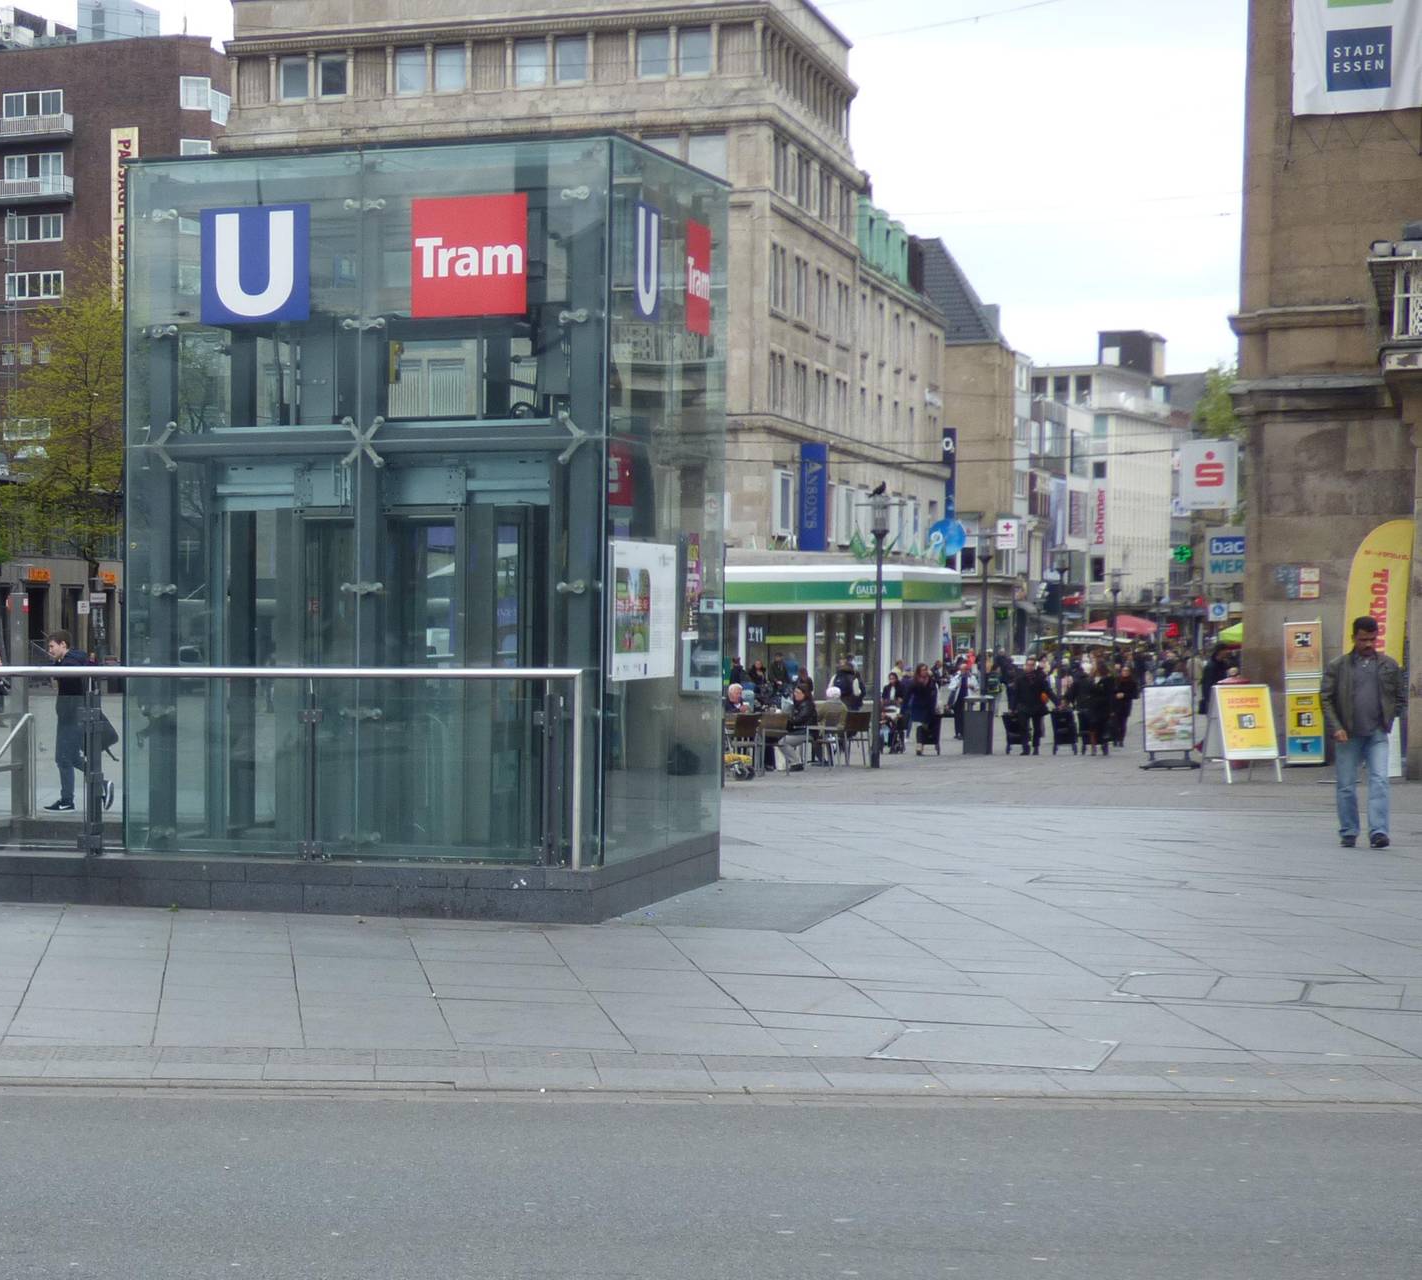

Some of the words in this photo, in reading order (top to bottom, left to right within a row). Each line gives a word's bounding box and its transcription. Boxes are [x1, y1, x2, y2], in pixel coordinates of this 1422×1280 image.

[1333, 43, 1385, 58] STADT
[1333, 59, 1385, 73] ESSEN
[215, 209, 295, 317] U
[414, 236, 524, 279] Tram
[637, 205, 659, 316] U
[687, 255, 711, 301] Tram
[1093, 488, 1106, 545] böhmer
